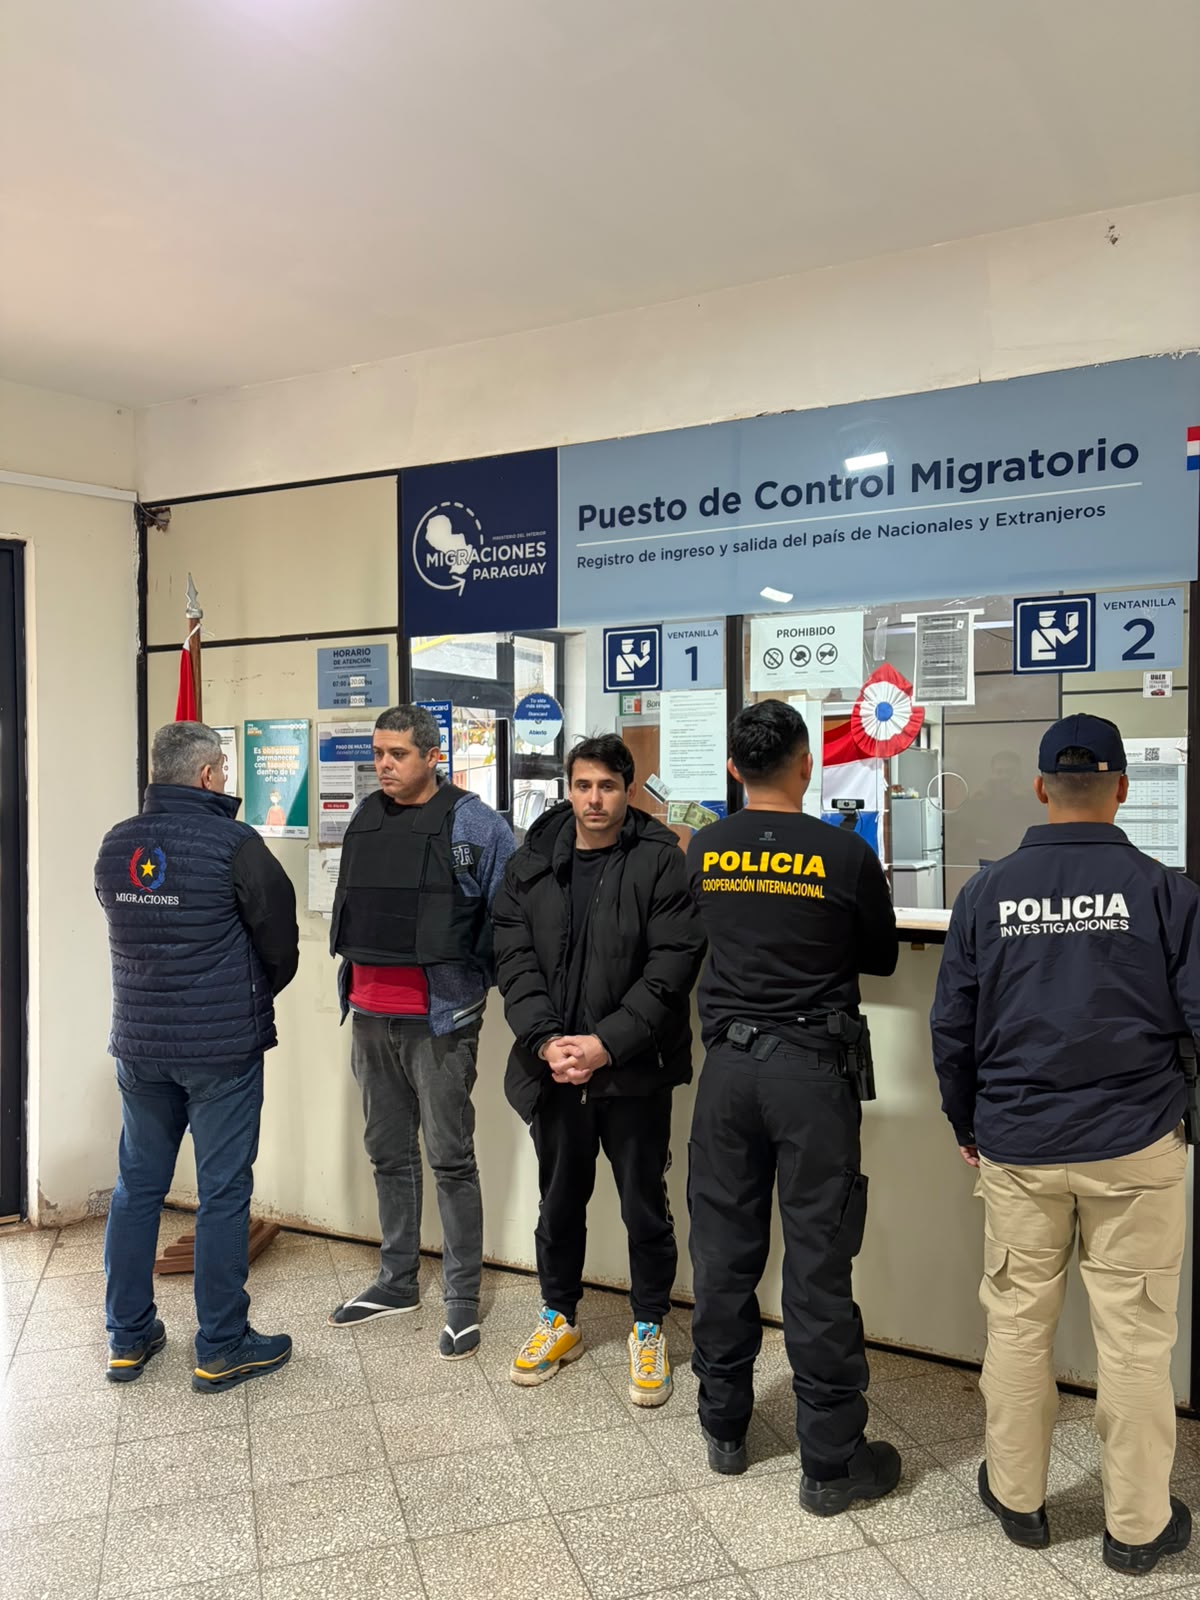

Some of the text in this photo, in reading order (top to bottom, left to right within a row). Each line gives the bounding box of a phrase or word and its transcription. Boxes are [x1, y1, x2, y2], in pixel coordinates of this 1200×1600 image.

[578, 438, 1139, 531] Puesto de Control Migratorio
[577, 505, 1106, 569] Registro de ingreso y salida del país de Nacionales y Extranjeros
[426, 541, 547, 568] MIGRACIONES
[472, 562, 547, 580] PARAGUAY
[1103, 597, 1176, 611] VENTANILLA
[667, 629, 719, 640] VENTANILLA
[776, 626, 836, 639] PROHIBIDO
[1121, 618, 1155, 661] 2
[333, 647, 371, 658] HORARIO
[342, 656, 372, 665] ATENCIÓN
[685, 646, 698, 681] 1
[702, 850, 826, 878] POLICIA
[702, 875, 825, 899] COOPERACIÓN INTERNACIONAL
[115, 892, 180, 905] MIGRACIONES
[999, 893, 1130, 925] POLICIA
[1000, 919, 1129, 938] INVESTIGACIONES
